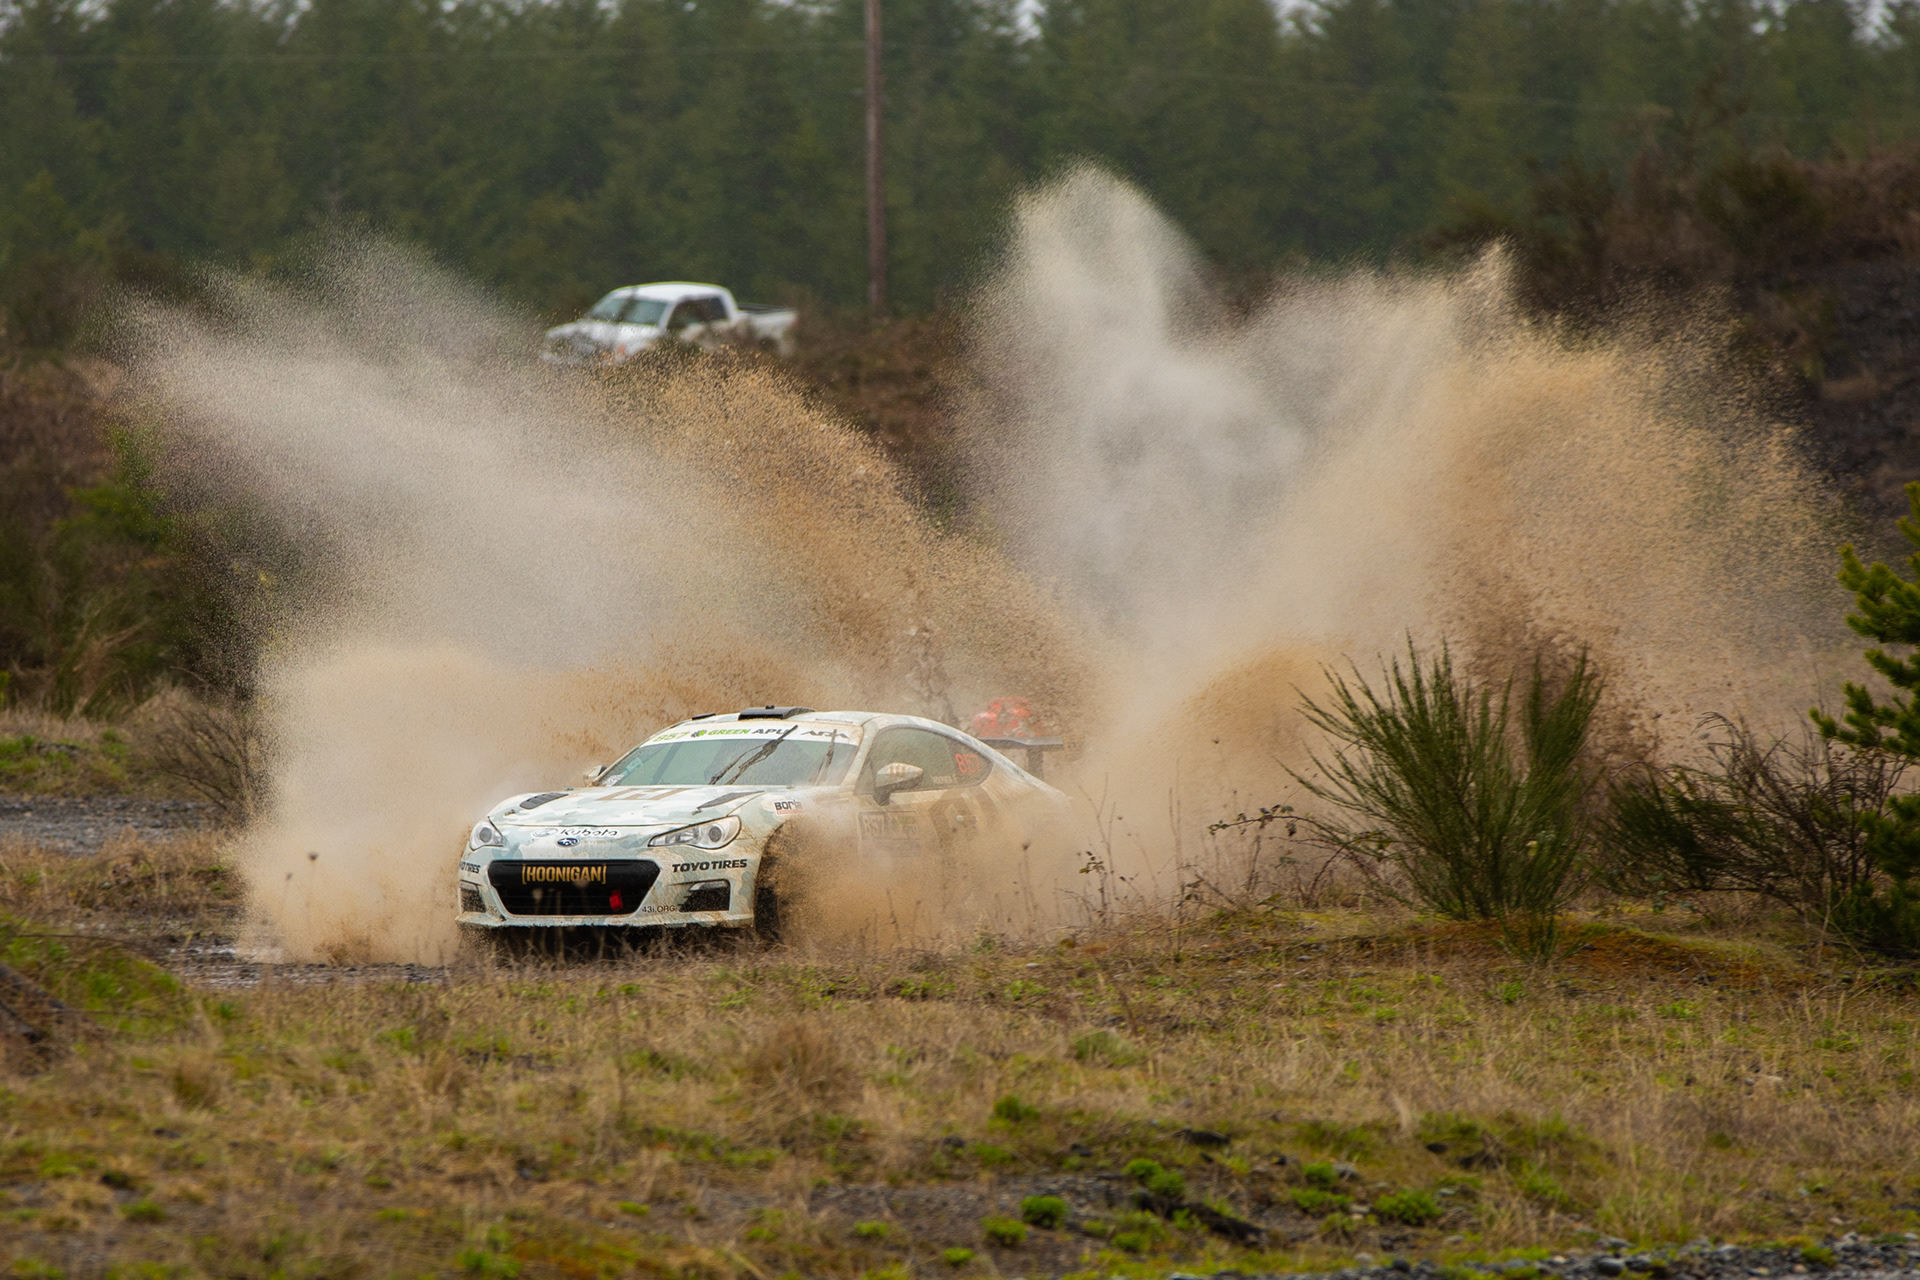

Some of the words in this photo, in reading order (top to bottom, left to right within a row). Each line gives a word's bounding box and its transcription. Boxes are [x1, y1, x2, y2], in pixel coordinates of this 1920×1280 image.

[708, 728, 751, 736] GREEN
[955, 753, 980, 773] 857
[560, 828, 619, 836] Kubota
[641, 904, 676, 913] 43i.ORG
